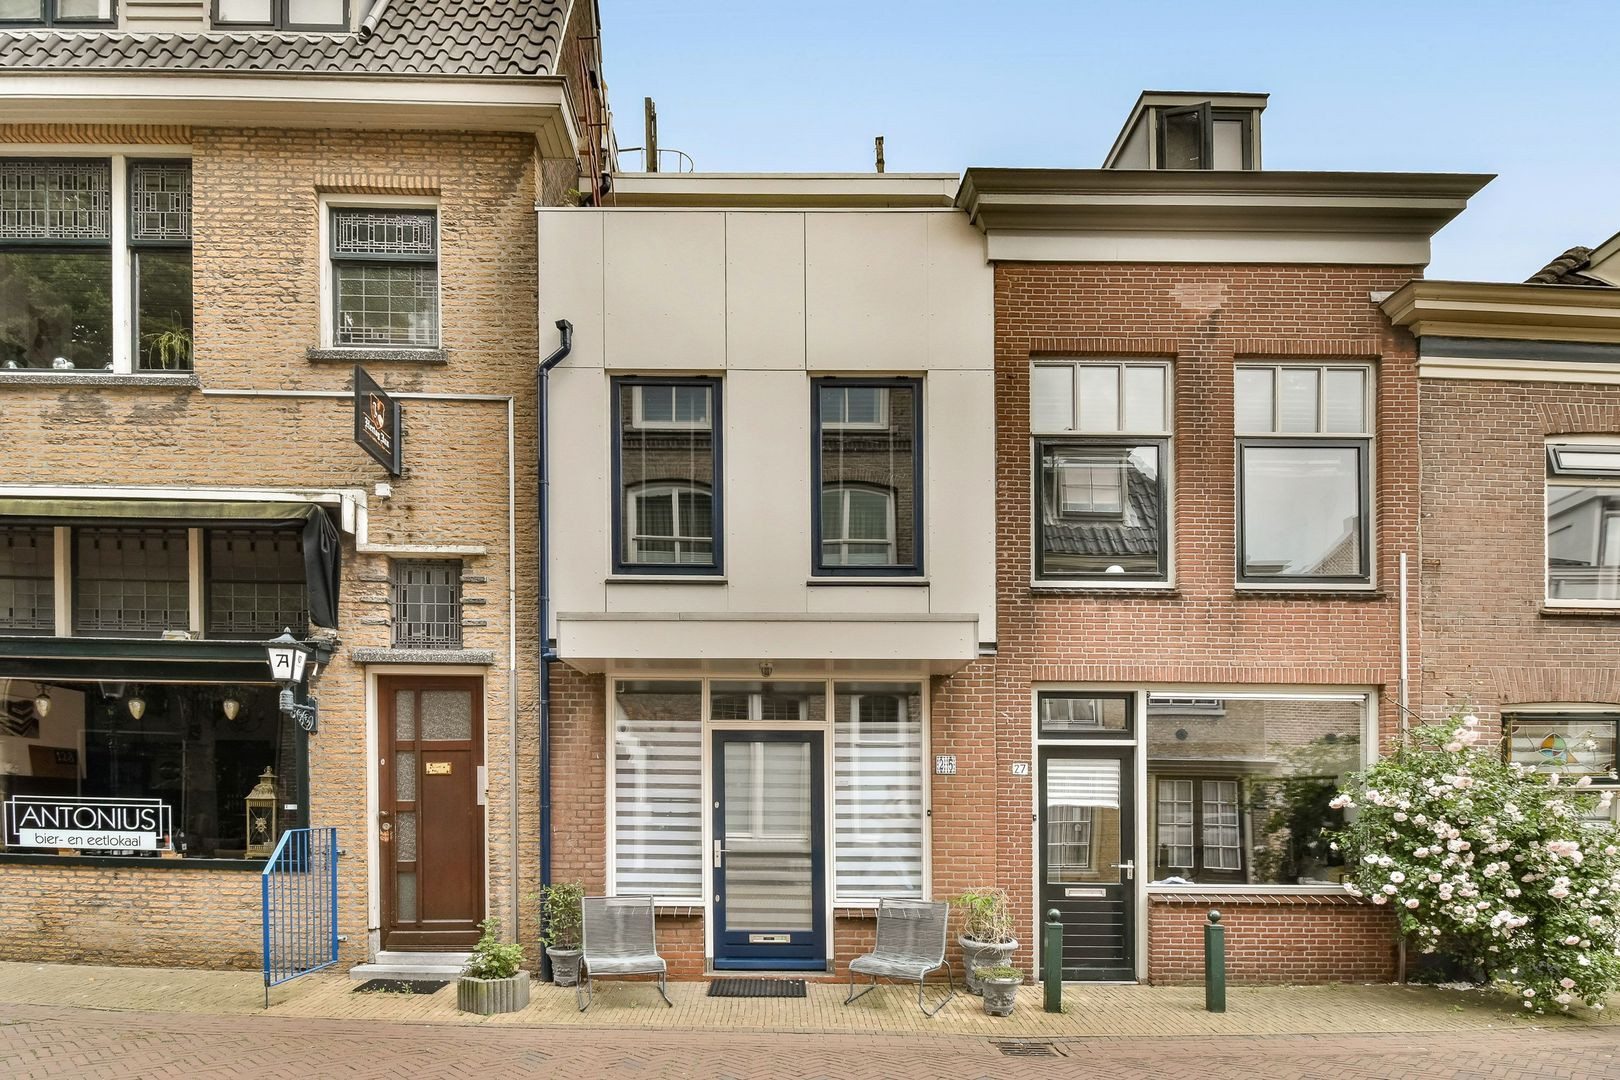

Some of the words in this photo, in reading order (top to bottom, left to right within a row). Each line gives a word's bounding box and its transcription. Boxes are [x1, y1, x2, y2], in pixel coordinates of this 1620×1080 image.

[938, 758, 954, 771] 25
[1014, 764, 1026, 774] 27
[19, 805, 156, 830] ANTONIUS
[34, 833, 63, 845] bier-
[67, 835, 83, 846] en
[87, 835, 141, 847] eetlokaal
